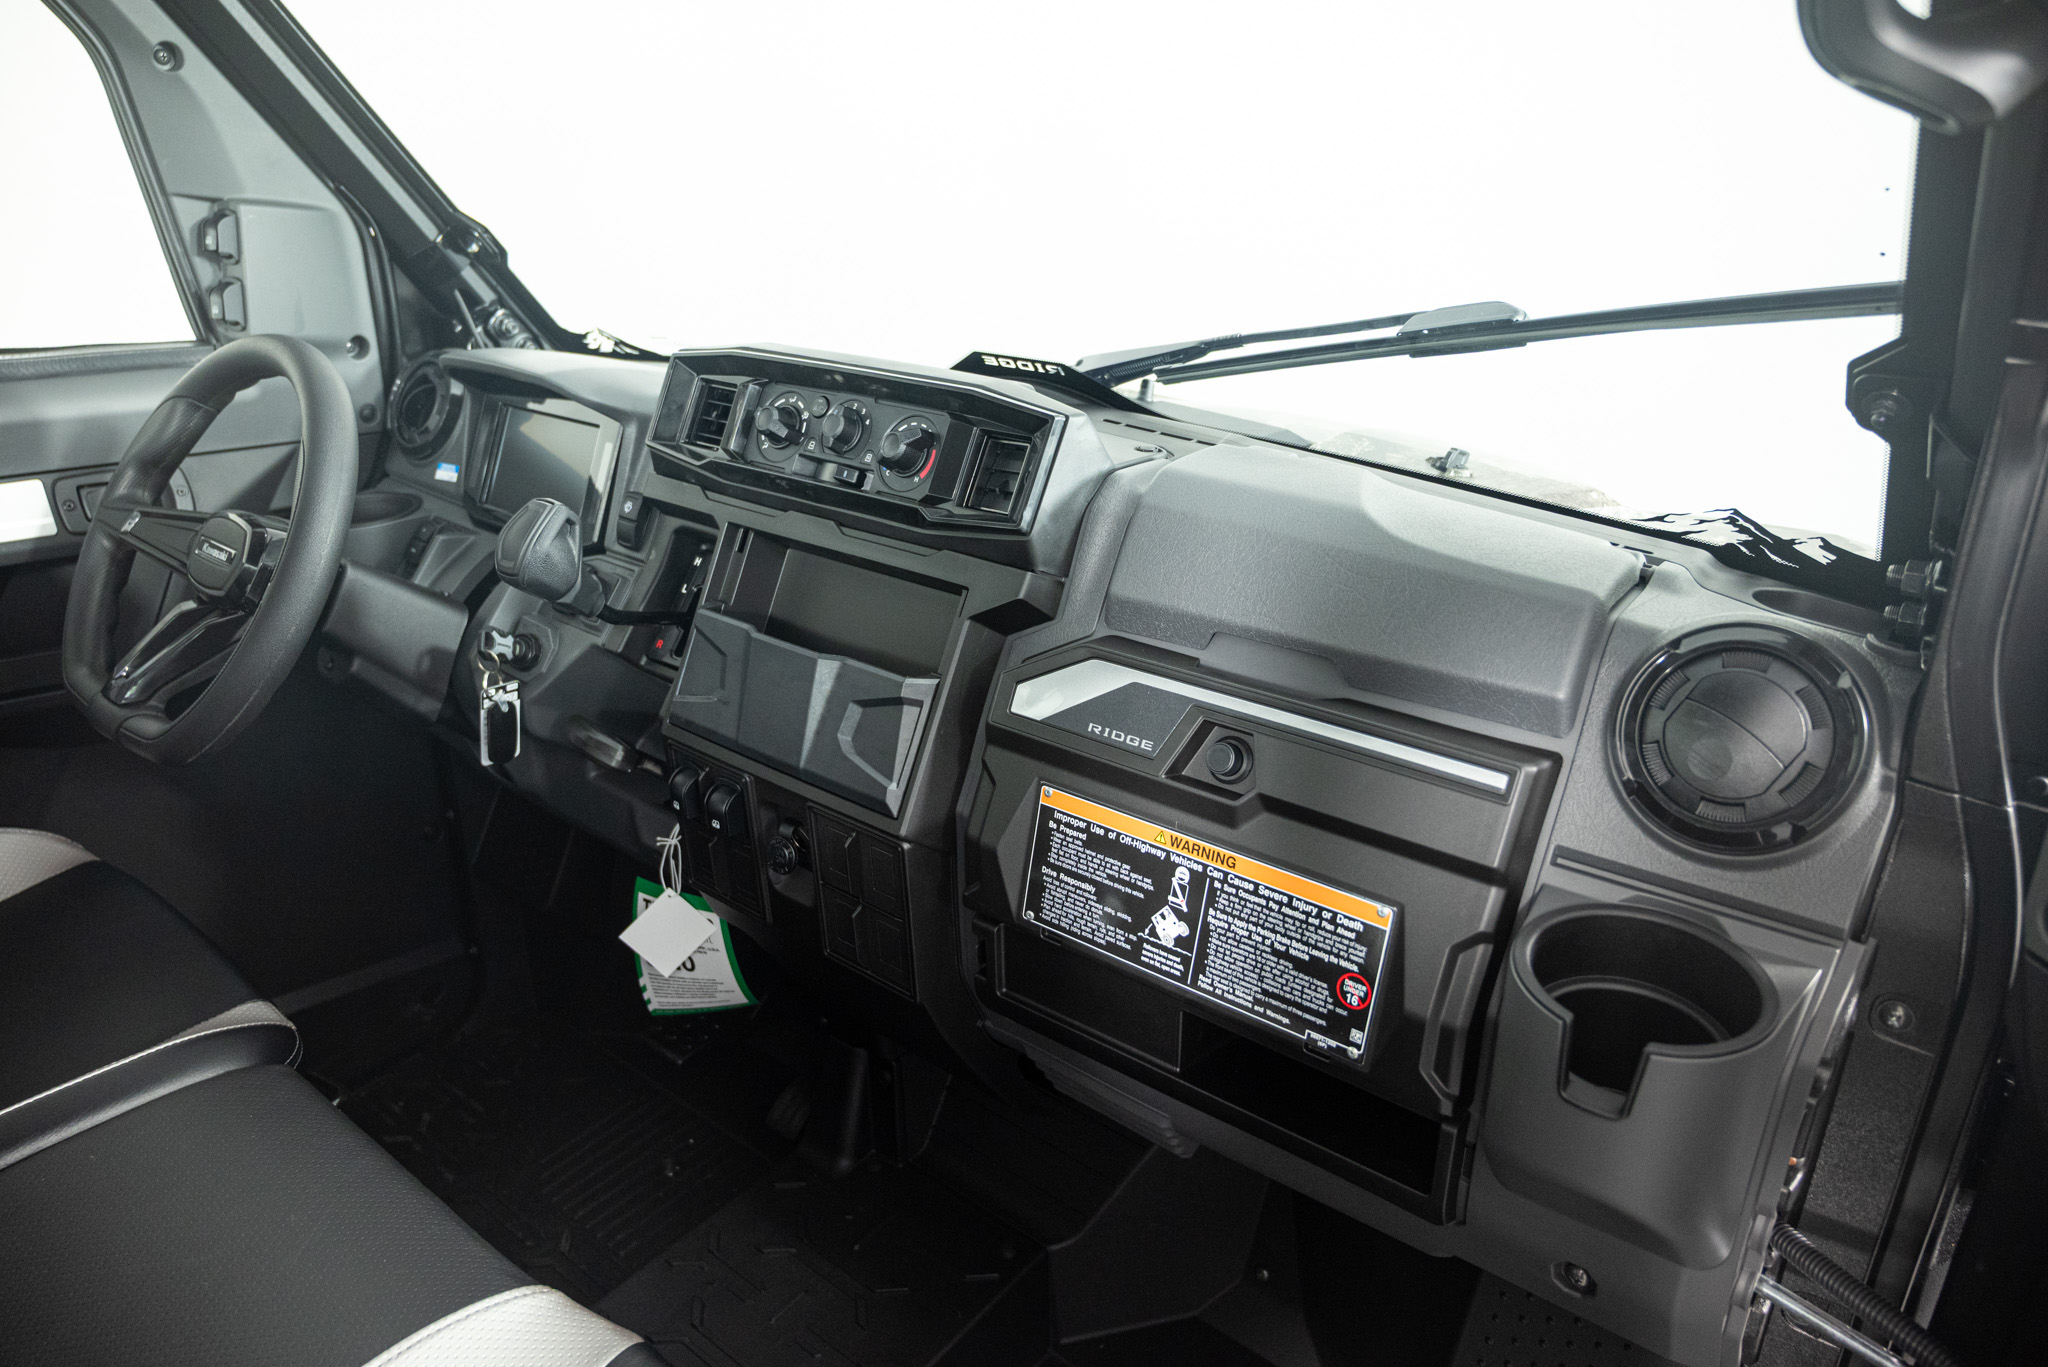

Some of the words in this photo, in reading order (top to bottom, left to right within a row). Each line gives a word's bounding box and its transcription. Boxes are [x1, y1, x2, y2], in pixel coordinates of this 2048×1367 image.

[202, 542, 229, 562] Kawasaki
[693, 556, 702, 567] H
[681, 583, 688, 594] L
[655, 639, 664, 649] R
[1088, 722, 1154, 751] RIDGE
[1049, 820, 1057, 829] Be
[1060, 824, 1087, 840] Prepared
[1169, 835, 1237, 870] WARNING
[1042, 866, 1057, 878] Drive
[1060, 873, 1096, 894] Responsibly
[1054, 810, 1087, 829] Improper
[1090, 823, 1105, 836] Use
[1108, 830, 1116, 840] of
[1119, 834, 1166, 860] Off-Highway
[1169, 853, 1203, 872] Vehicles
[1207, 866, 1224, 880] Can
[1227, 874, 1255, 891] Cause
[1258, 885, 1289, 904] Severe
[1292, 898, 1318, 917] Injury
[1322, 910, 1332, 920] or
[1336, 914, 1364, 932] Death
[1214, 880, 1222, 889] Be
[1223, 884, 1236, 894] Sure
[1238, 889, 1267, 906] Occupants
[1269, 901, 1279, 912] Pay
[1281, 906, 1306, 921] Attention
[1308, 916, 1319, 926] and
[1321, 921, 1335, 931] Plan
[1336, 926, 1356, 939] Ahead
[1208, 915, 1228, 929] Require
[1231, 924, 1249, 937] Proper
[1251, 933, 1263, 942] Use
[1264, 938, 1271, 946] of
[1273, 941, 1286, 952] Your
[1288, 947, 1309, 961] Vehicle
[1209, 908, 1216, 916] Be
[1216, 911, 1228, 921] Sure
[1228, 915, 1233, 923] to
[1234, 918, 1248, 930] Apply
[1248, 923, 1257, 932] the
[1257, 927, 1276, 941] Parking
[1276, 934, 1291, 946] Brake
[1291, 940, 1309, 952] Before
[1309, 947, 1329, 962] Leaving
[1329, 955, 1339, 964] the
[1339, 958, 1360, 972] Vehicle.
[1199, 974, 1212, 984] Read
[1213, 980, 1233, 993] Owner's
[1235, 989, 1254, 1002] Manual.
[1343, 985, 1365, 998] UNDER
[1344, 978, 1367, 993] DRIVER
[1346, 993, 1359, 1006] 16
[1198, 981, 1213, 992] Follow
[1224, 991, 1252, 1008] Instructions
[1254, 1004, 1264, 1013] and
[1266, 1009, 1291, 1024] Warnings.
